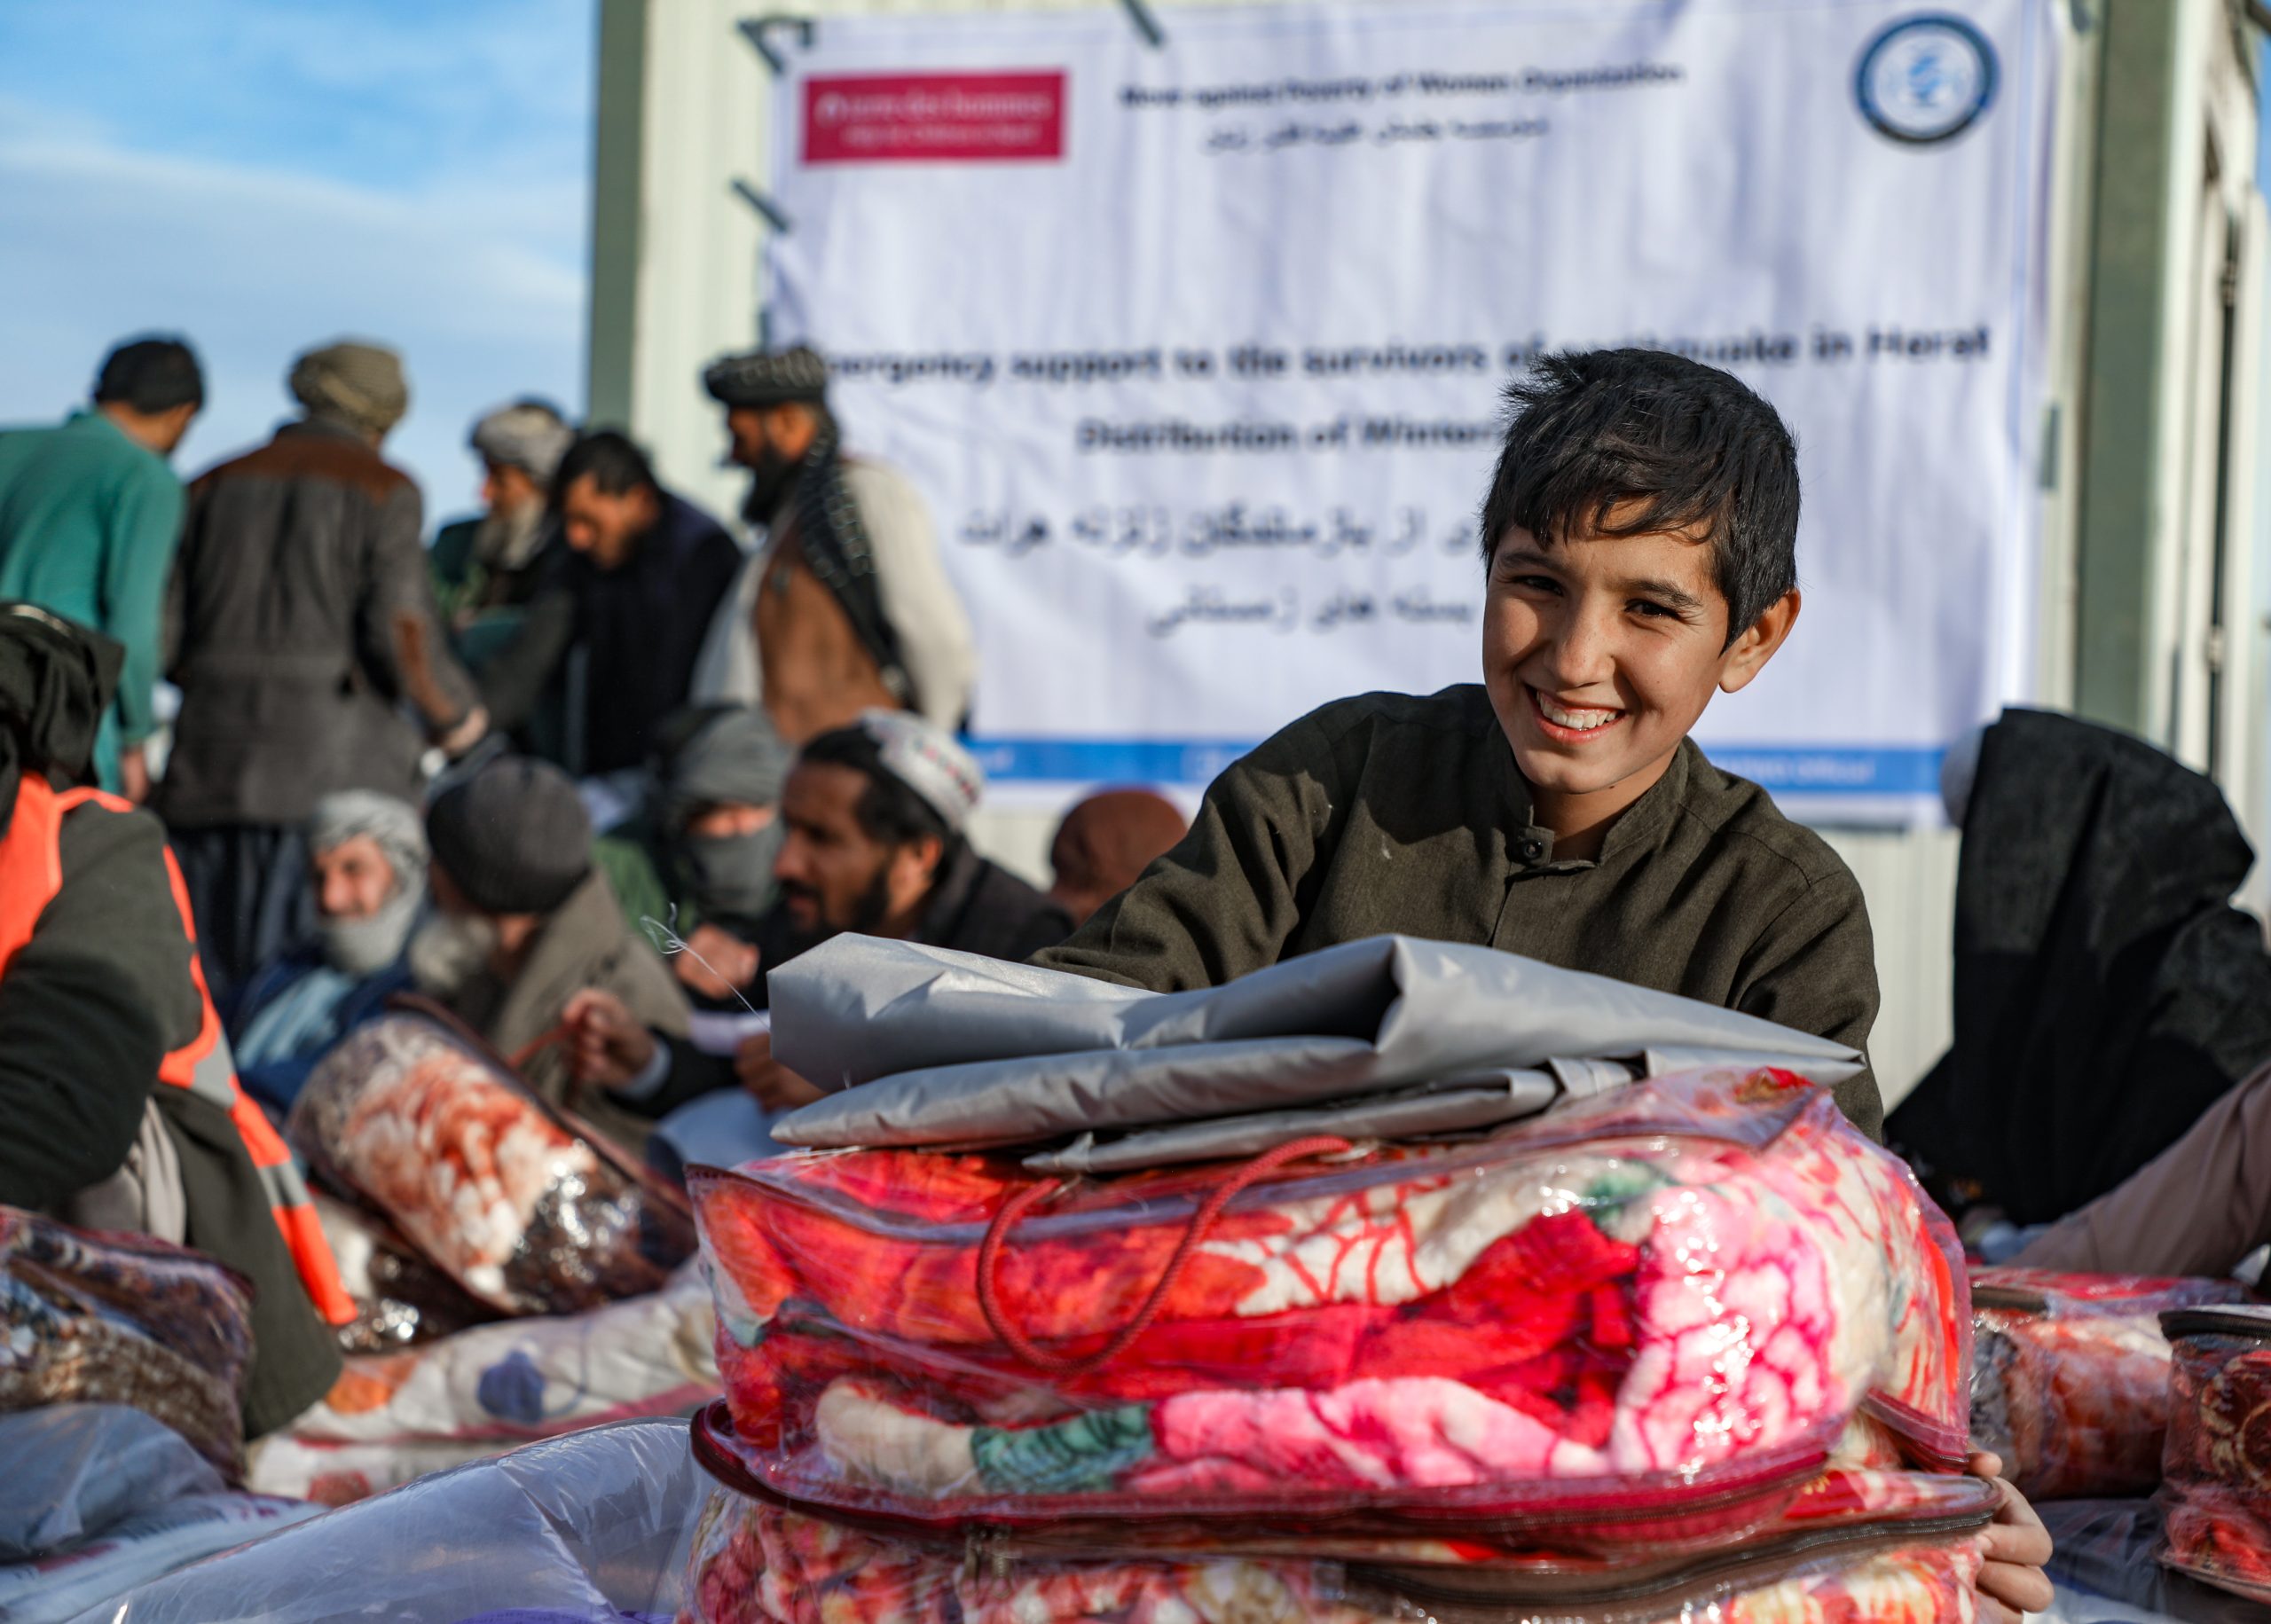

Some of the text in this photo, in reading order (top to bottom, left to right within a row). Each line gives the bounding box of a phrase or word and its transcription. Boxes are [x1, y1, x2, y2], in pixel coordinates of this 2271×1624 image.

[1120, 62, 1686, 110] Move against Poverty of Women Organization
[1010, 348, 1162, 384] support
[1173, 350, 1215, 378] to
[1228, 342, 1291, 376] the
[1301, 337, 1489, 376] survivors
[1812, 326, 1853, 362] in
[1866, 323, 1992, 360] Herat
[1077, 417, 1297, 451] Distribution
[1308, 416, 1352, 450] of
[957, 509, 1052, 554] هرات
[1182, 500, 1371, 555] بازماندگان
